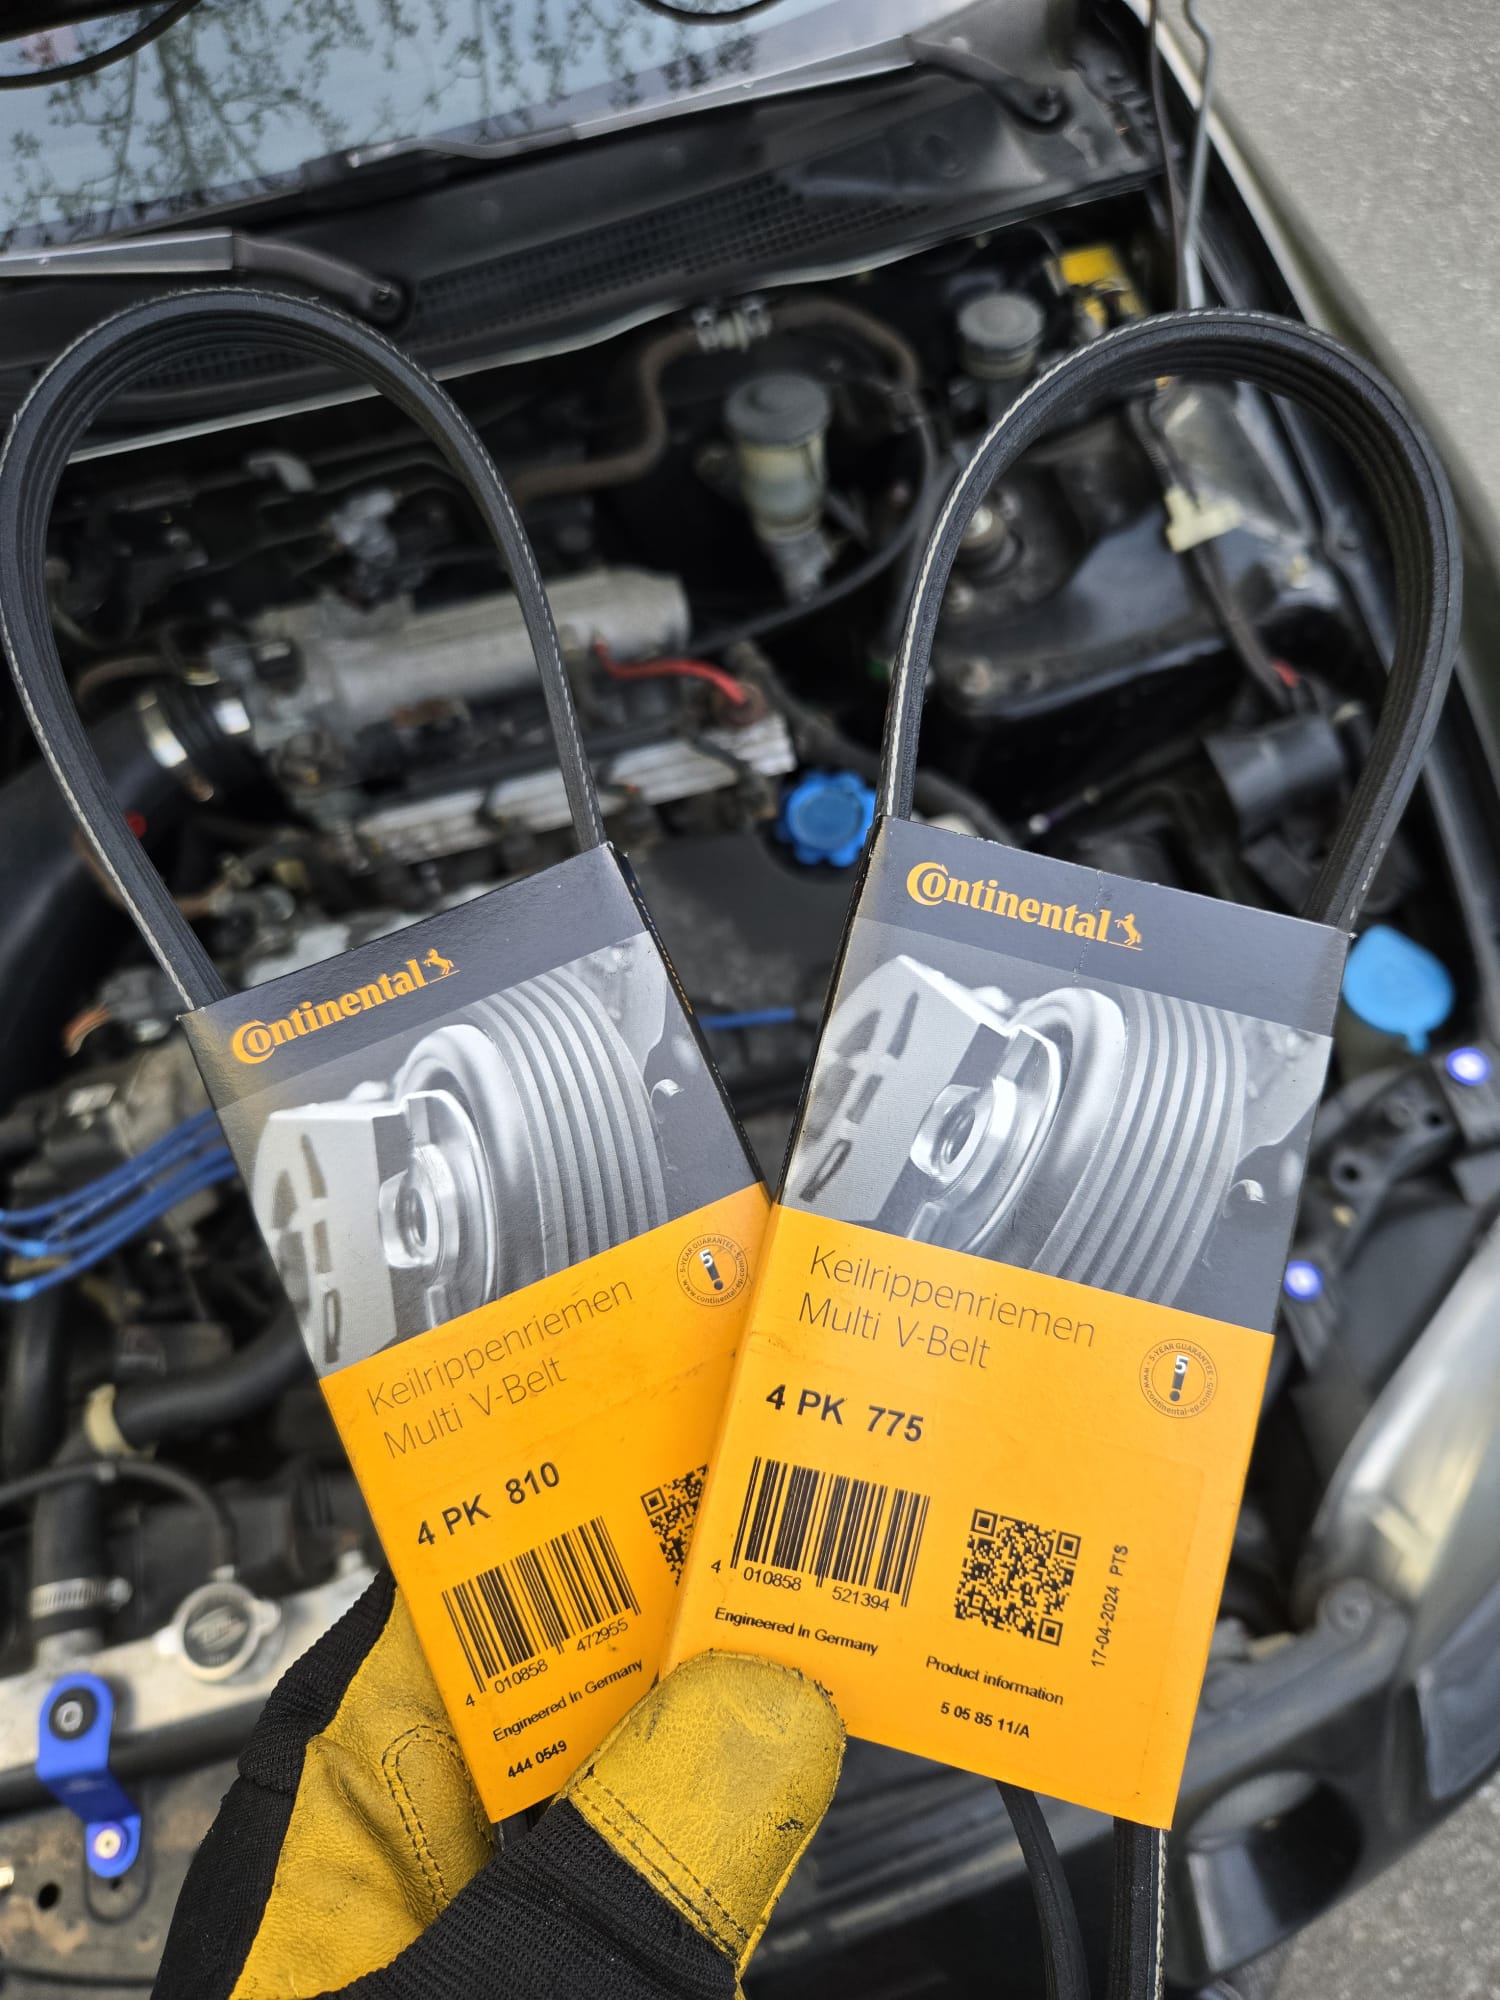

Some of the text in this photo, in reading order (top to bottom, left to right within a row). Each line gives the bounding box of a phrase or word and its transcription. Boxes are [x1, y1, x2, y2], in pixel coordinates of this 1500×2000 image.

[906, 862, 1112, 943] Continental
[231, 959, 429, 1064] Continental
[799, 1292, 991, 1369] Multi V-Belt
[810, 1245, 1095, 1348] Keilrippenriemen
[366, 1281, 633, 1416] Keilrippenriemen
[384, 1357, 567, 1459] Multi V-Belt
[766, 1384, 924, 1442] 4 PK 775
[418, 1461, 560, 1545] 4 PK 810
[711, 1560, 890, 1612] 4 010858 521394
[1091, 1545, 1128, 1667] 17-04-2024 PTS
[465, 1617, 629, 1707] 4 010858 472955
[714, 1607, 879, 1656] Engineered In Germany
[492, 1659, 643, 1742] Engineered In Germany
[926, 1655, 1064, 1705] Product information
[940, 1701, 1030, 1738] 5 05 85 11/A
[507, 1740, 568, 1778] 444 0549
